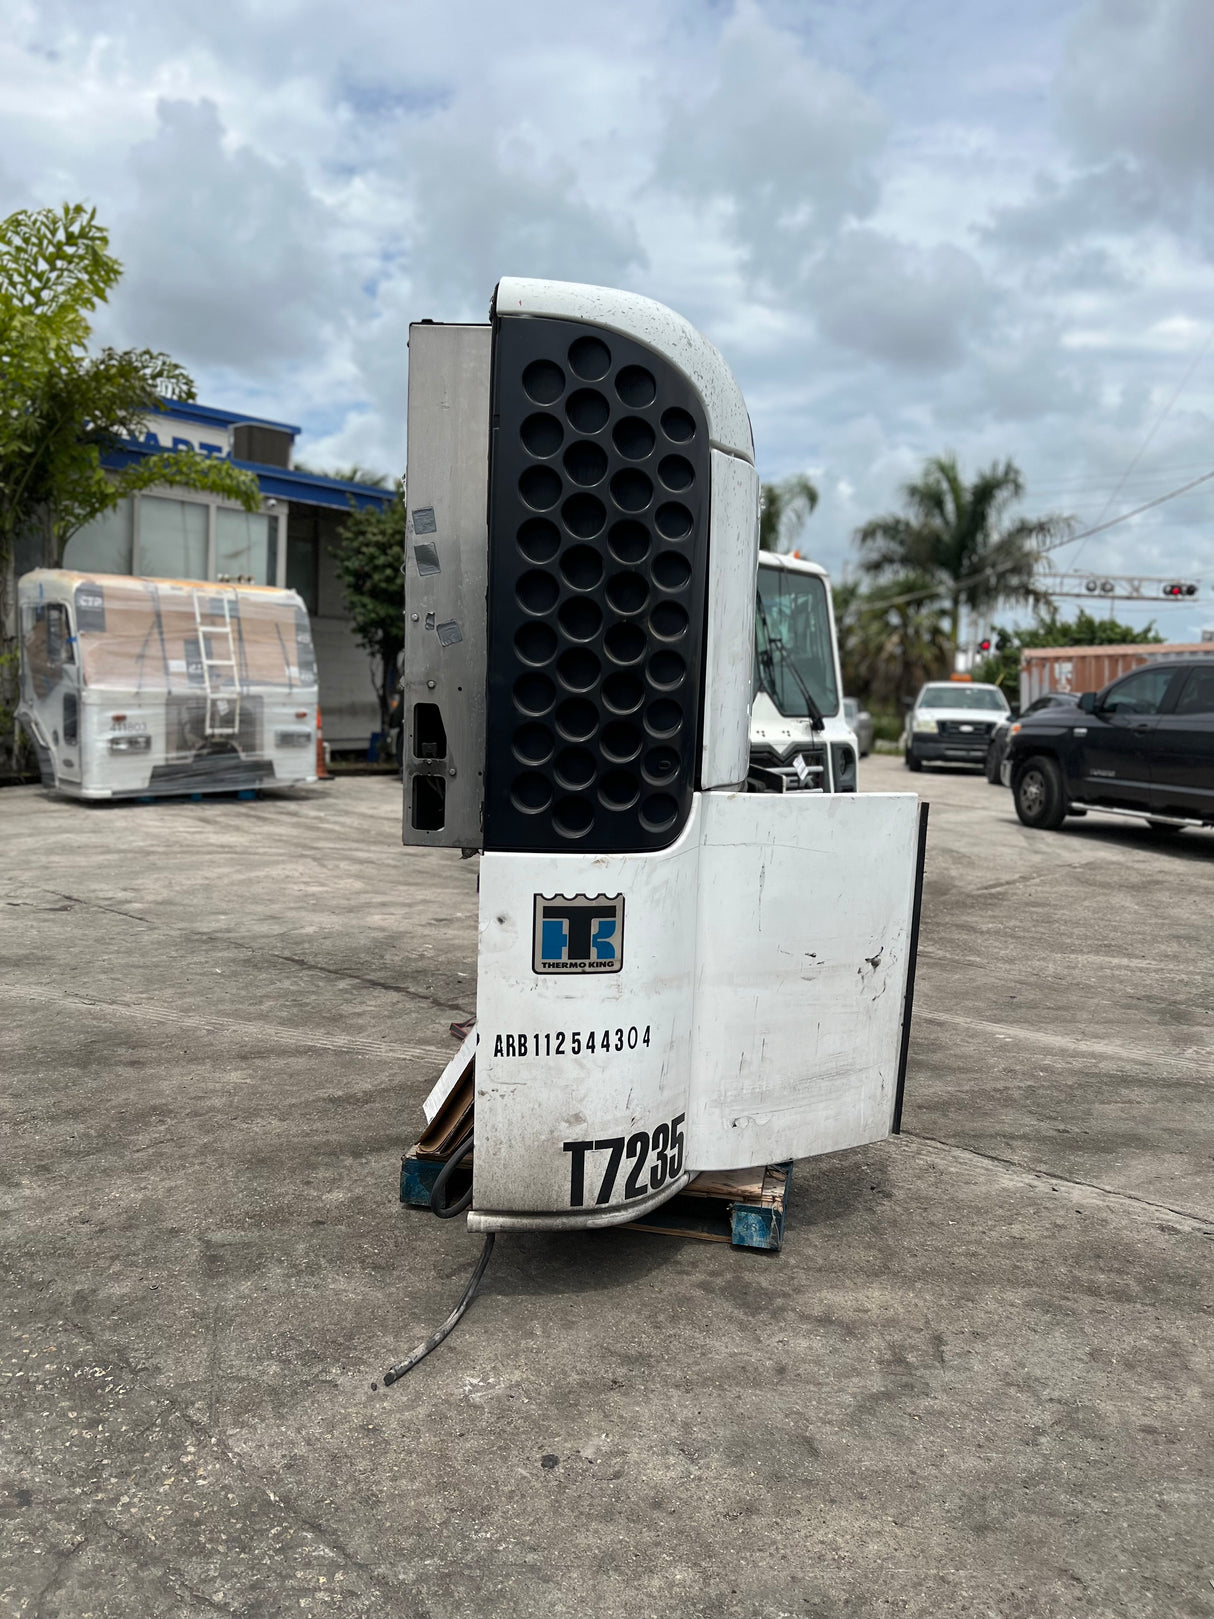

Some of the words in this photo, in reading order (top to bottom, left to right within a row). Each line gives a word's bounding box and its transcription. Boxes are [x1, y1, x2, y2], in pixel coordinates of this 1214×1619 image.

[541, 961, 587, 969] THERMO
[588, 960, 615, 968] KING
[562, 1112, 686, 1207] T7235
